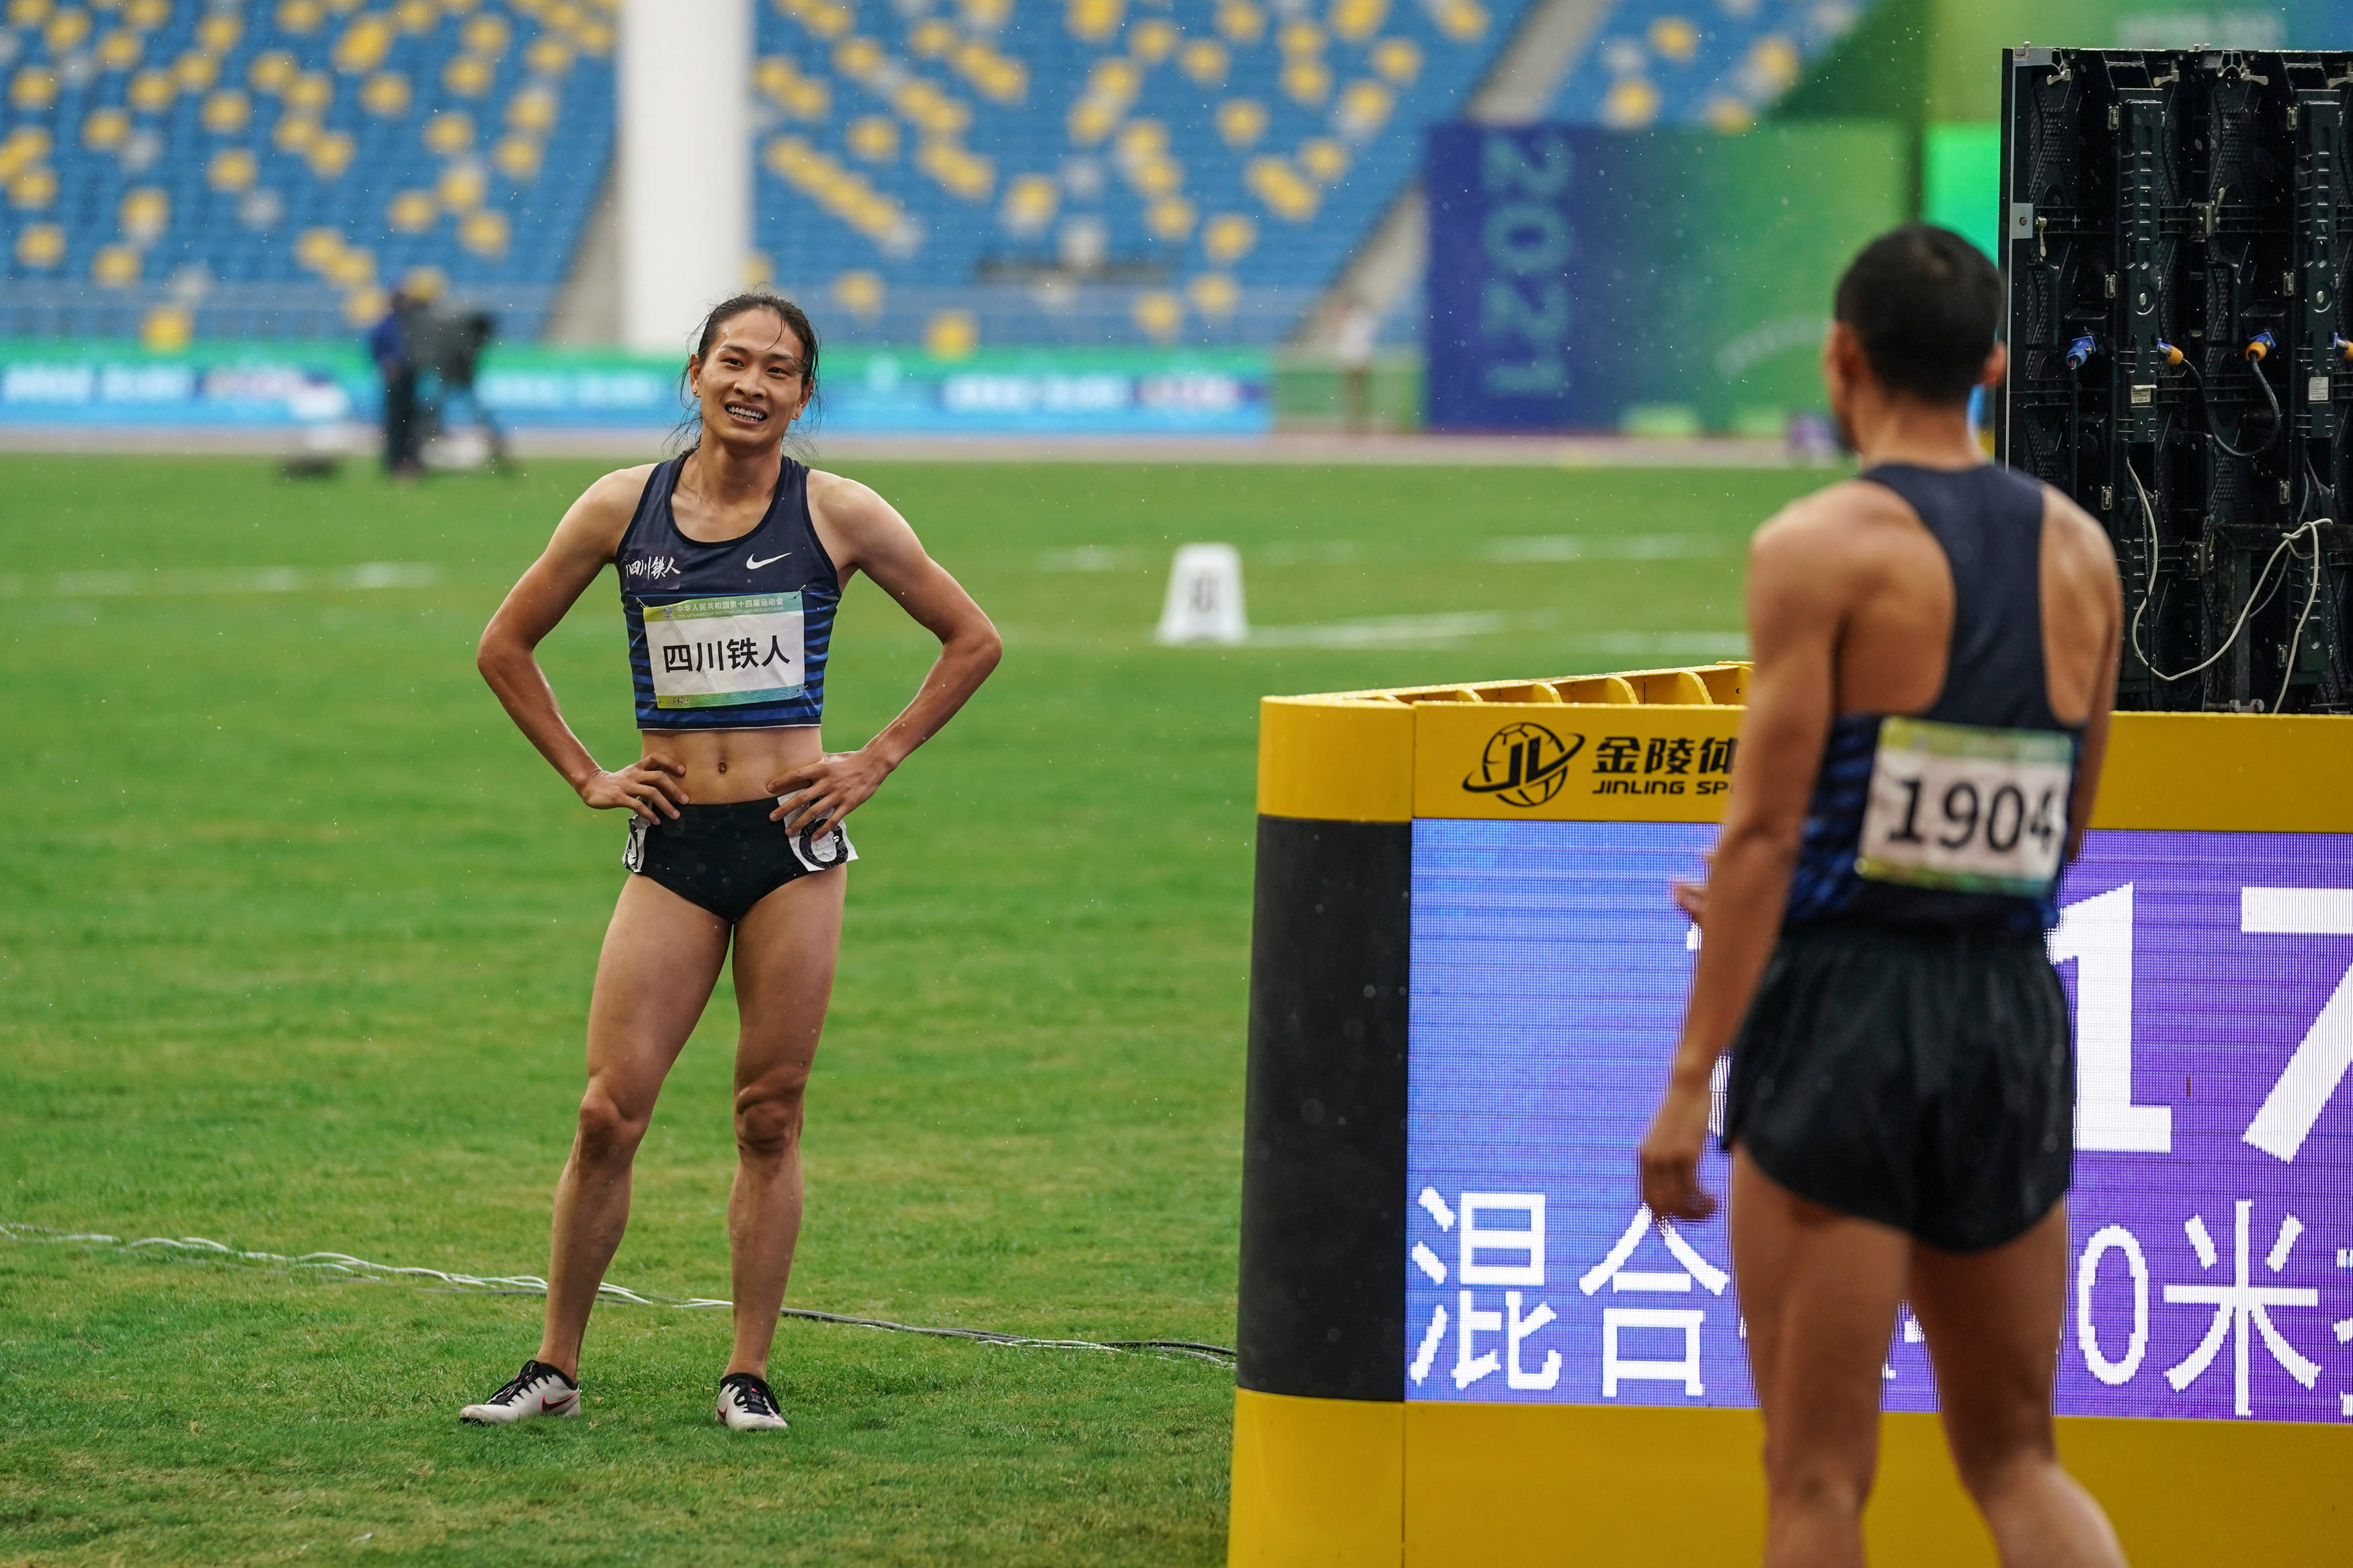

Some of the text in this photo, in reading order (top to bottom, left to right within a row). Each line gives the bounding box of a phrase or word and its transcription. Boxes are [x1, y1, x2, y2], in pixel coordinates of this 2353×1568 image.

[1480, 134, 1572, 395] 2021
[676, 597, 783, 613] 中华人民共和国第十四届运动会
[663, 635, 791, 673] 四川铁人
[1592, 780, 1737, 795] JINLING SP
[1885, 776, 2057, 854] 1904
[2078, 1199, 2353, 1418] 0米
